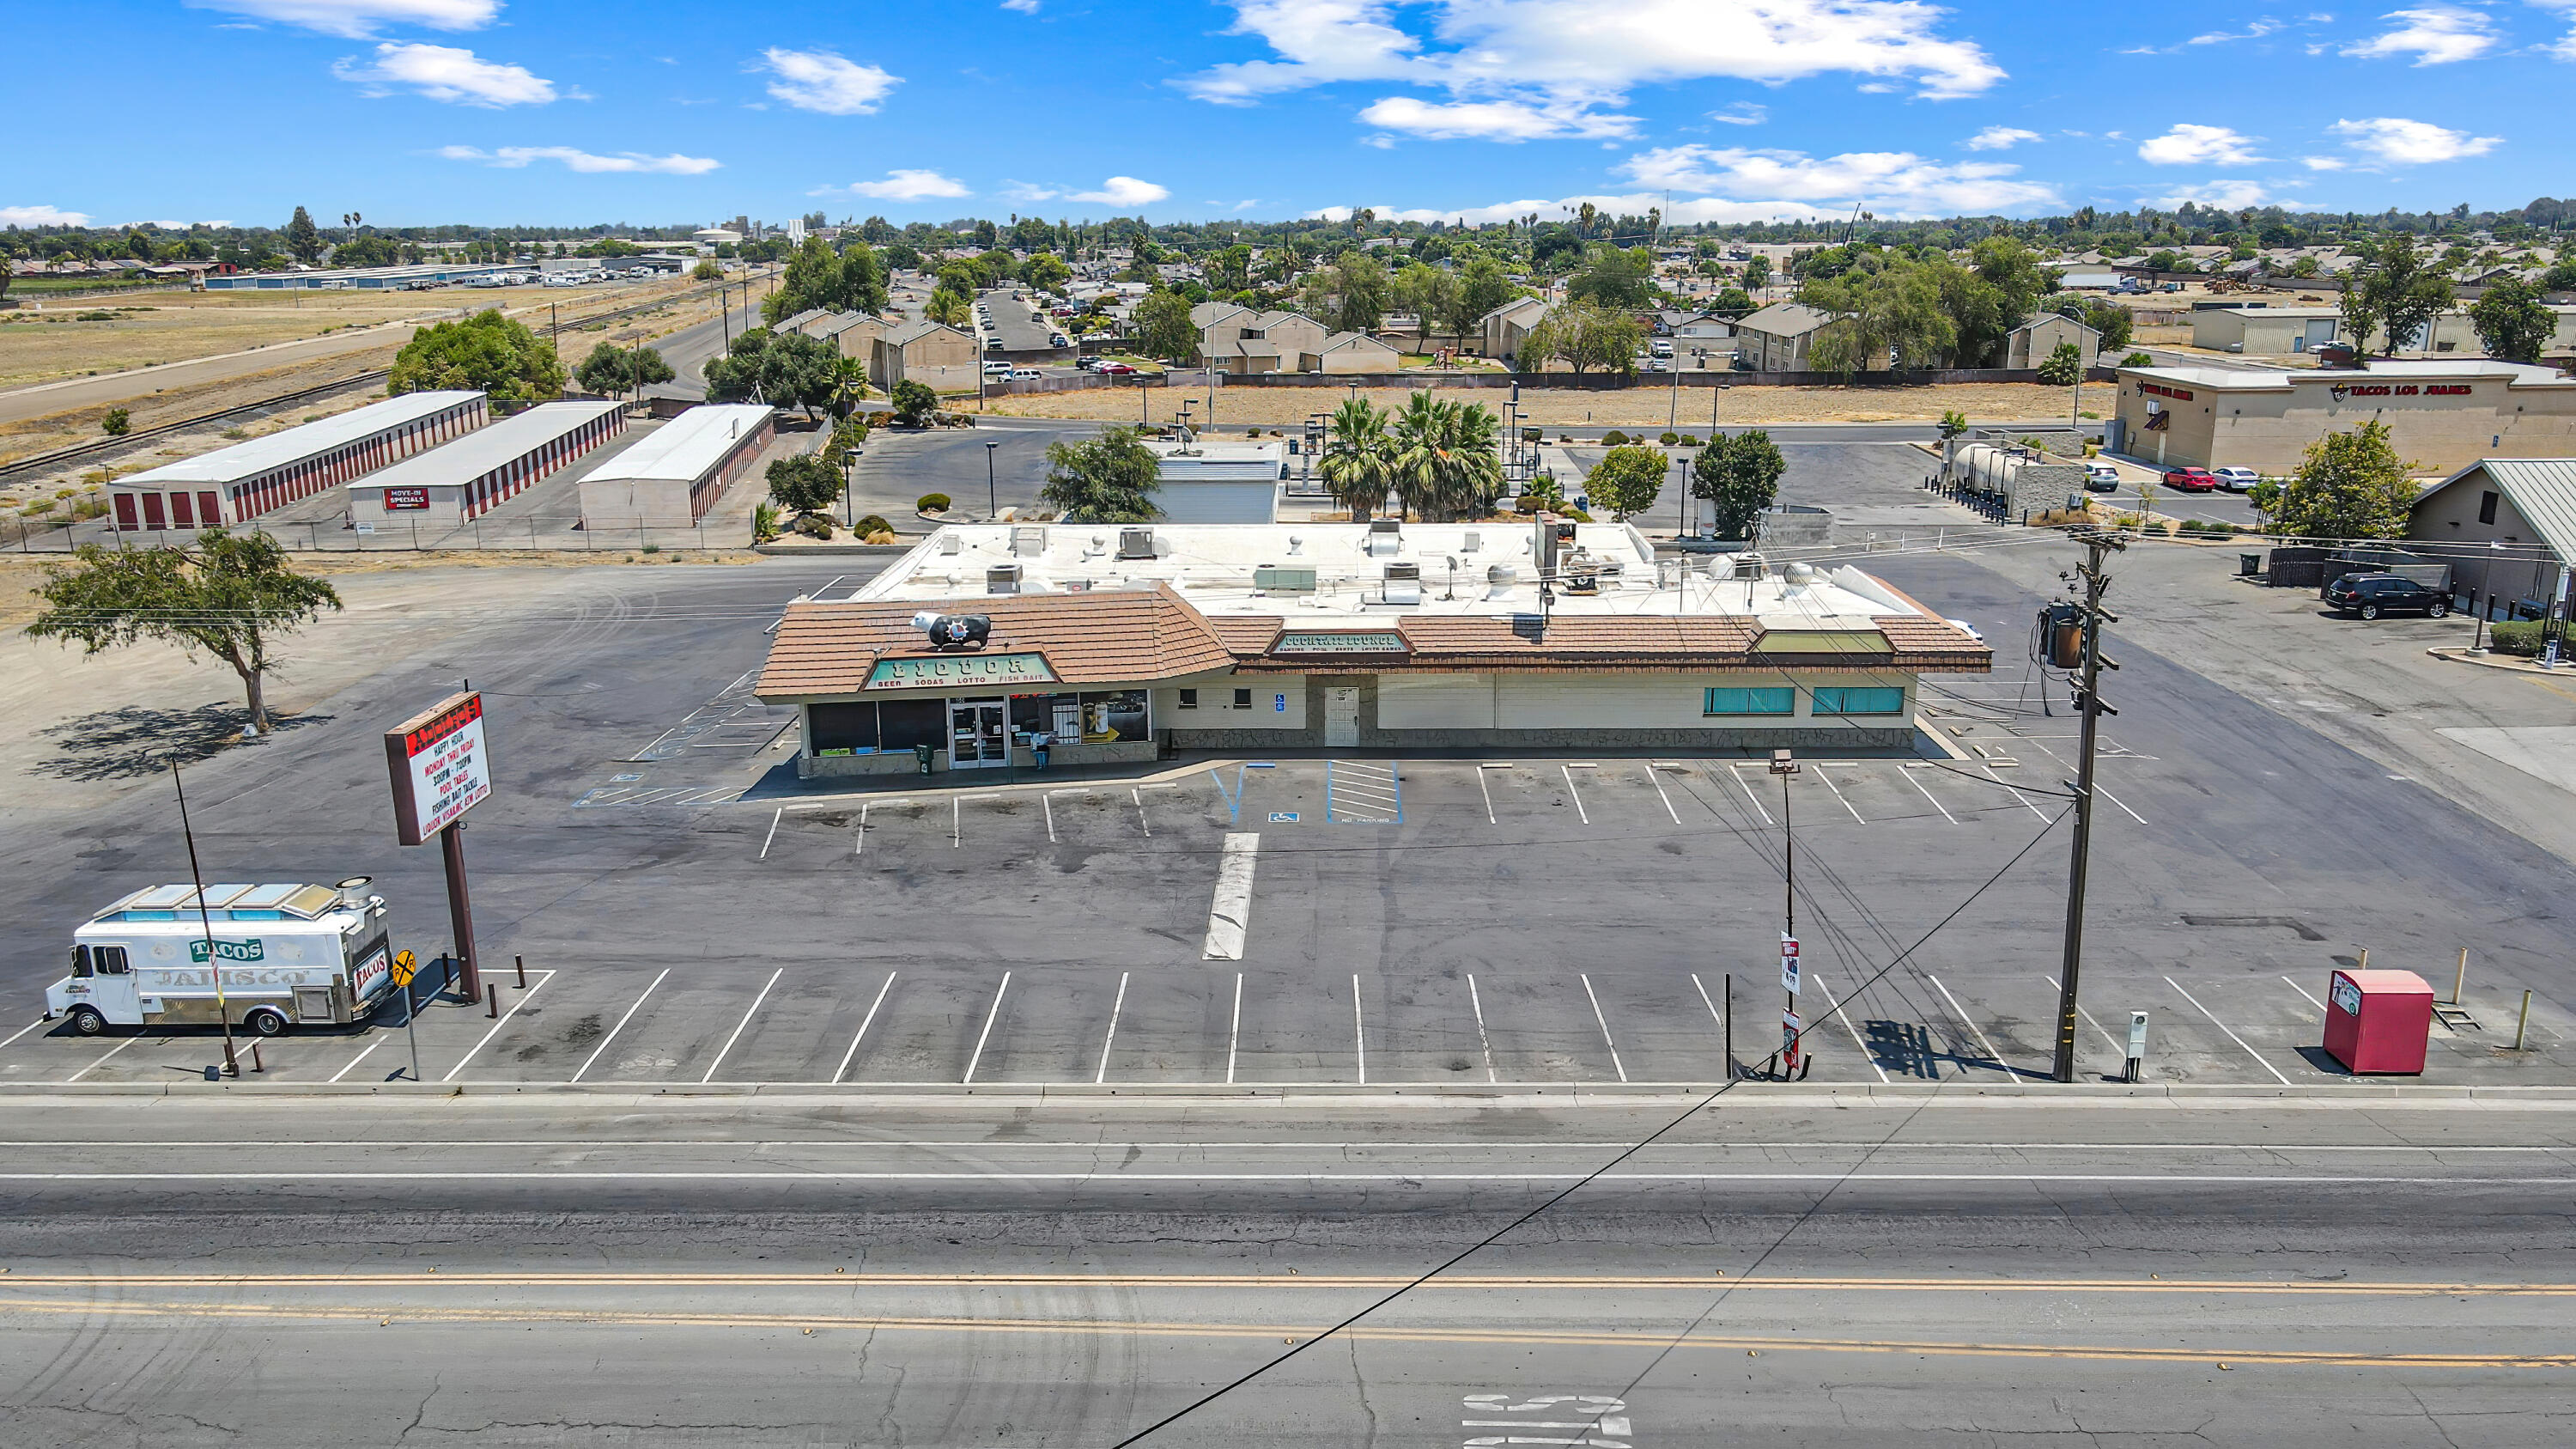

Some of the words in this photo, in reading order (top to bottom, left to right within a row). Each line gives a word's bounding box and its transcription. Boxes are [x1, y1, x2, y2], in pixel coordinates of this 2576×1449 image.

[2350, 386, 2391, 396] TACOS
[2395, 386, 2419, 395] LOS
[2423, 385, 2472, 395] JUANES
[1285, 636, 1344, 646] COCKTAIL
[1346, 636, 1394, 645] LOUNGE
[893, 657, 1024, 678] LIQUOR
[424, 756, 446, 777] MONDAY
[447, 749, 459, 764] THRU
[460, 738, 475, 756] FRIDAY
[434, 738, 450, 758] HAPPY
[432, 795, 451, 816] FISHING
[463, 776, 478, 795] TACKLE
[440, 781, 453, 797] POOL
[191, 941, 262, 959] TACOS
[355, 955, 386, 991] TACOS
